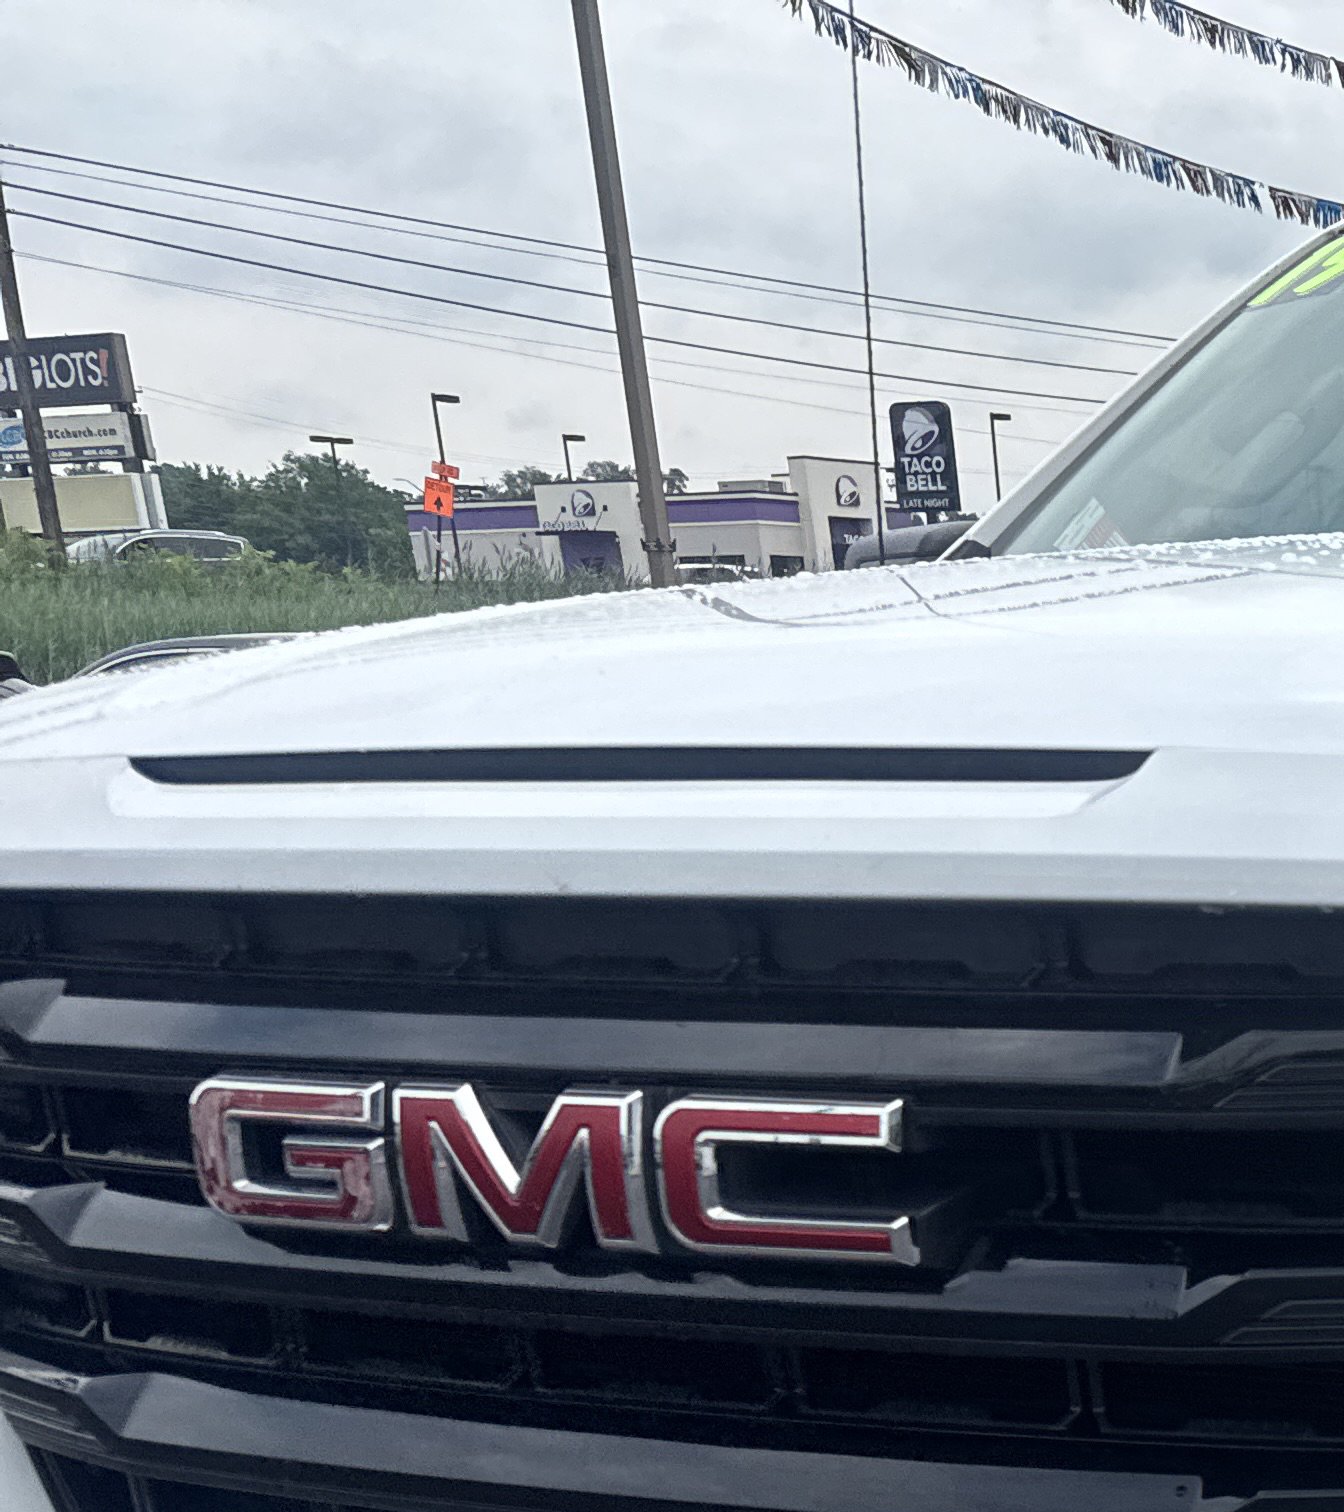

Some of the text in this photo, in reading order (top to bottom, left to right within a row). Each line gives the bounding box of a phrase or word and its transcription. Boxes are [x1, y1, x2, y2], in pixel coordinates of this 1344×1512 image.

[900, 455, 946, 474] TACO
[905, 474, 948, 491] BELL
[903, 498, 950, 509] LATE NIGHT
[188, 1074, 921, 1267] GMC
